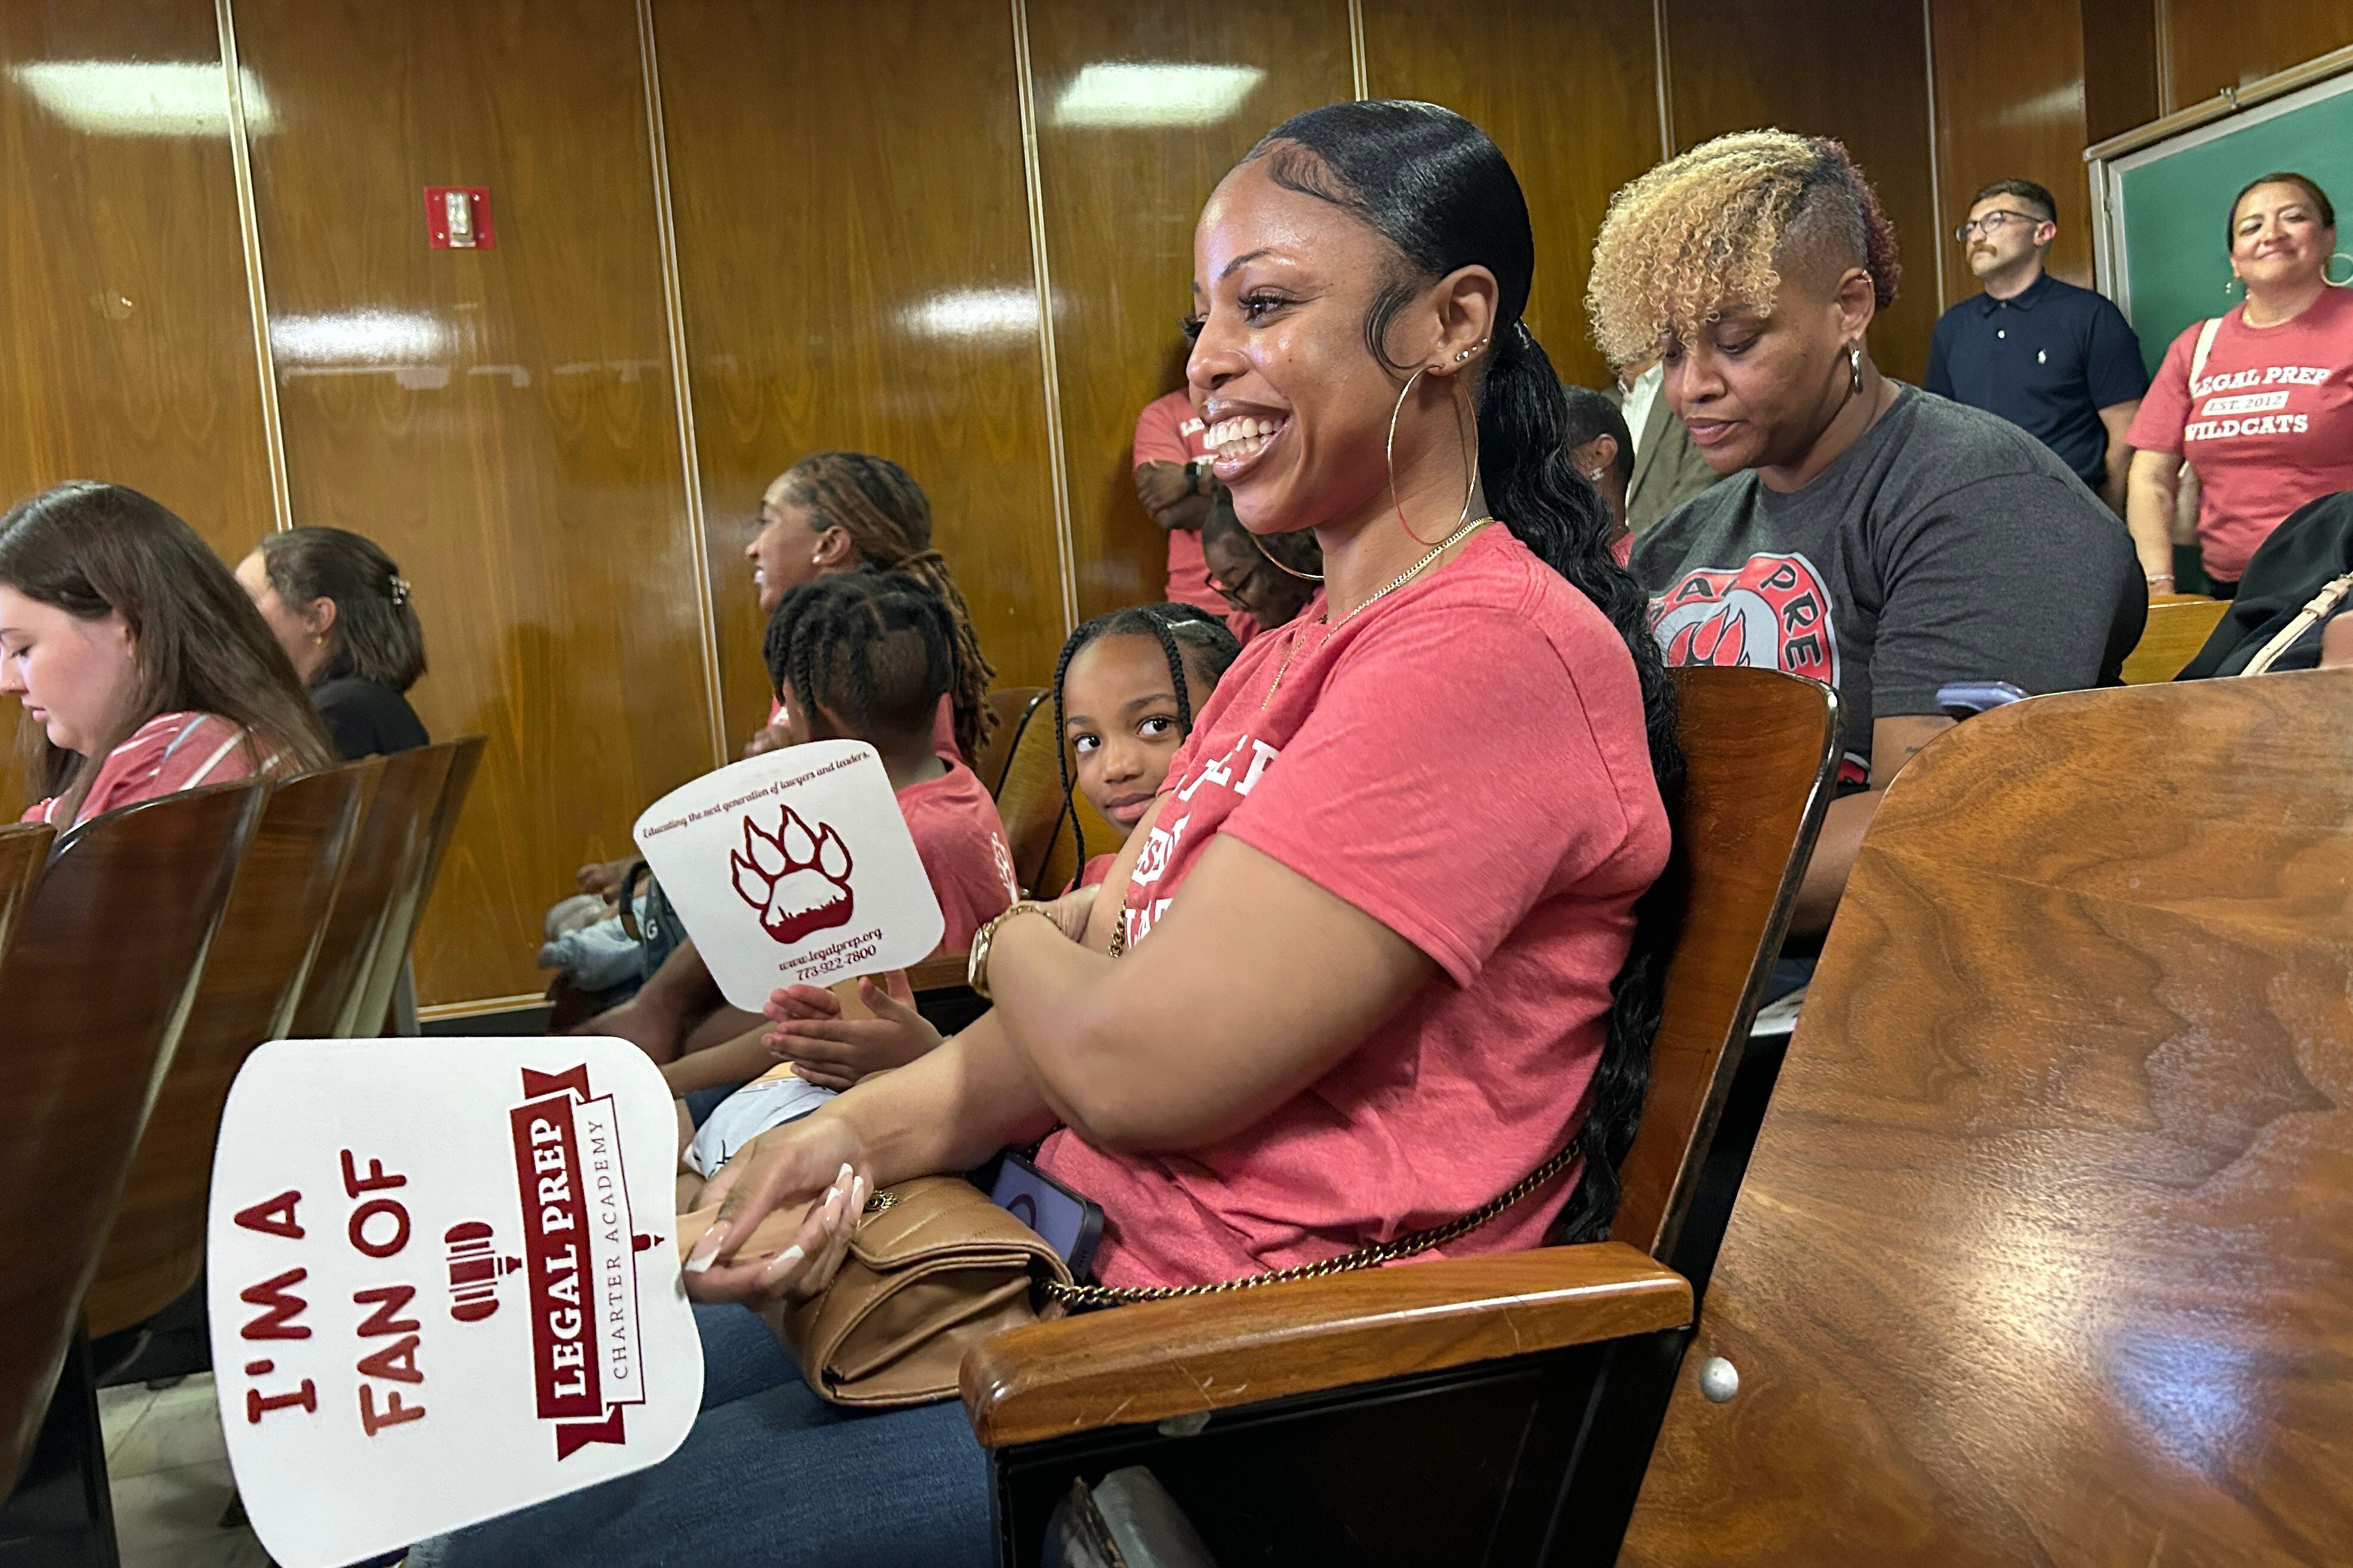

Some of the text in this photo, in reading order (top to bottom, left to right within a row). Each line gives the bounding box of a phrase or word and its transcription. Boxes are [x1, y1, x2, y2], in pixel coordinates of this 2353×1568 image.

[2245, 395, 2283, 409] 2012
[2261, 365, 2331, 386] PREP
[1758, 563, 1824, 680] PRE
[689, 812, 702, 822] the
[704, 803, 721, 816] next
[722, 788, 768, 812] generation
[770, 781, 779, 794] of
[780, 772, 816, 789] lawyers
[817, 762, 835, 776] and
[779, 928, 883, 971] www.legalprep.org
[796, 944, 877, 981] 773-922-7800
[340, 1149, 426, 1437] FAN OF
[530, 1118, 586, 1398] LEGAL PREP
[589, 1121, 628, 1380] CHARTER ACADEMY
[234, 1190, 318, 1424] I'M A
